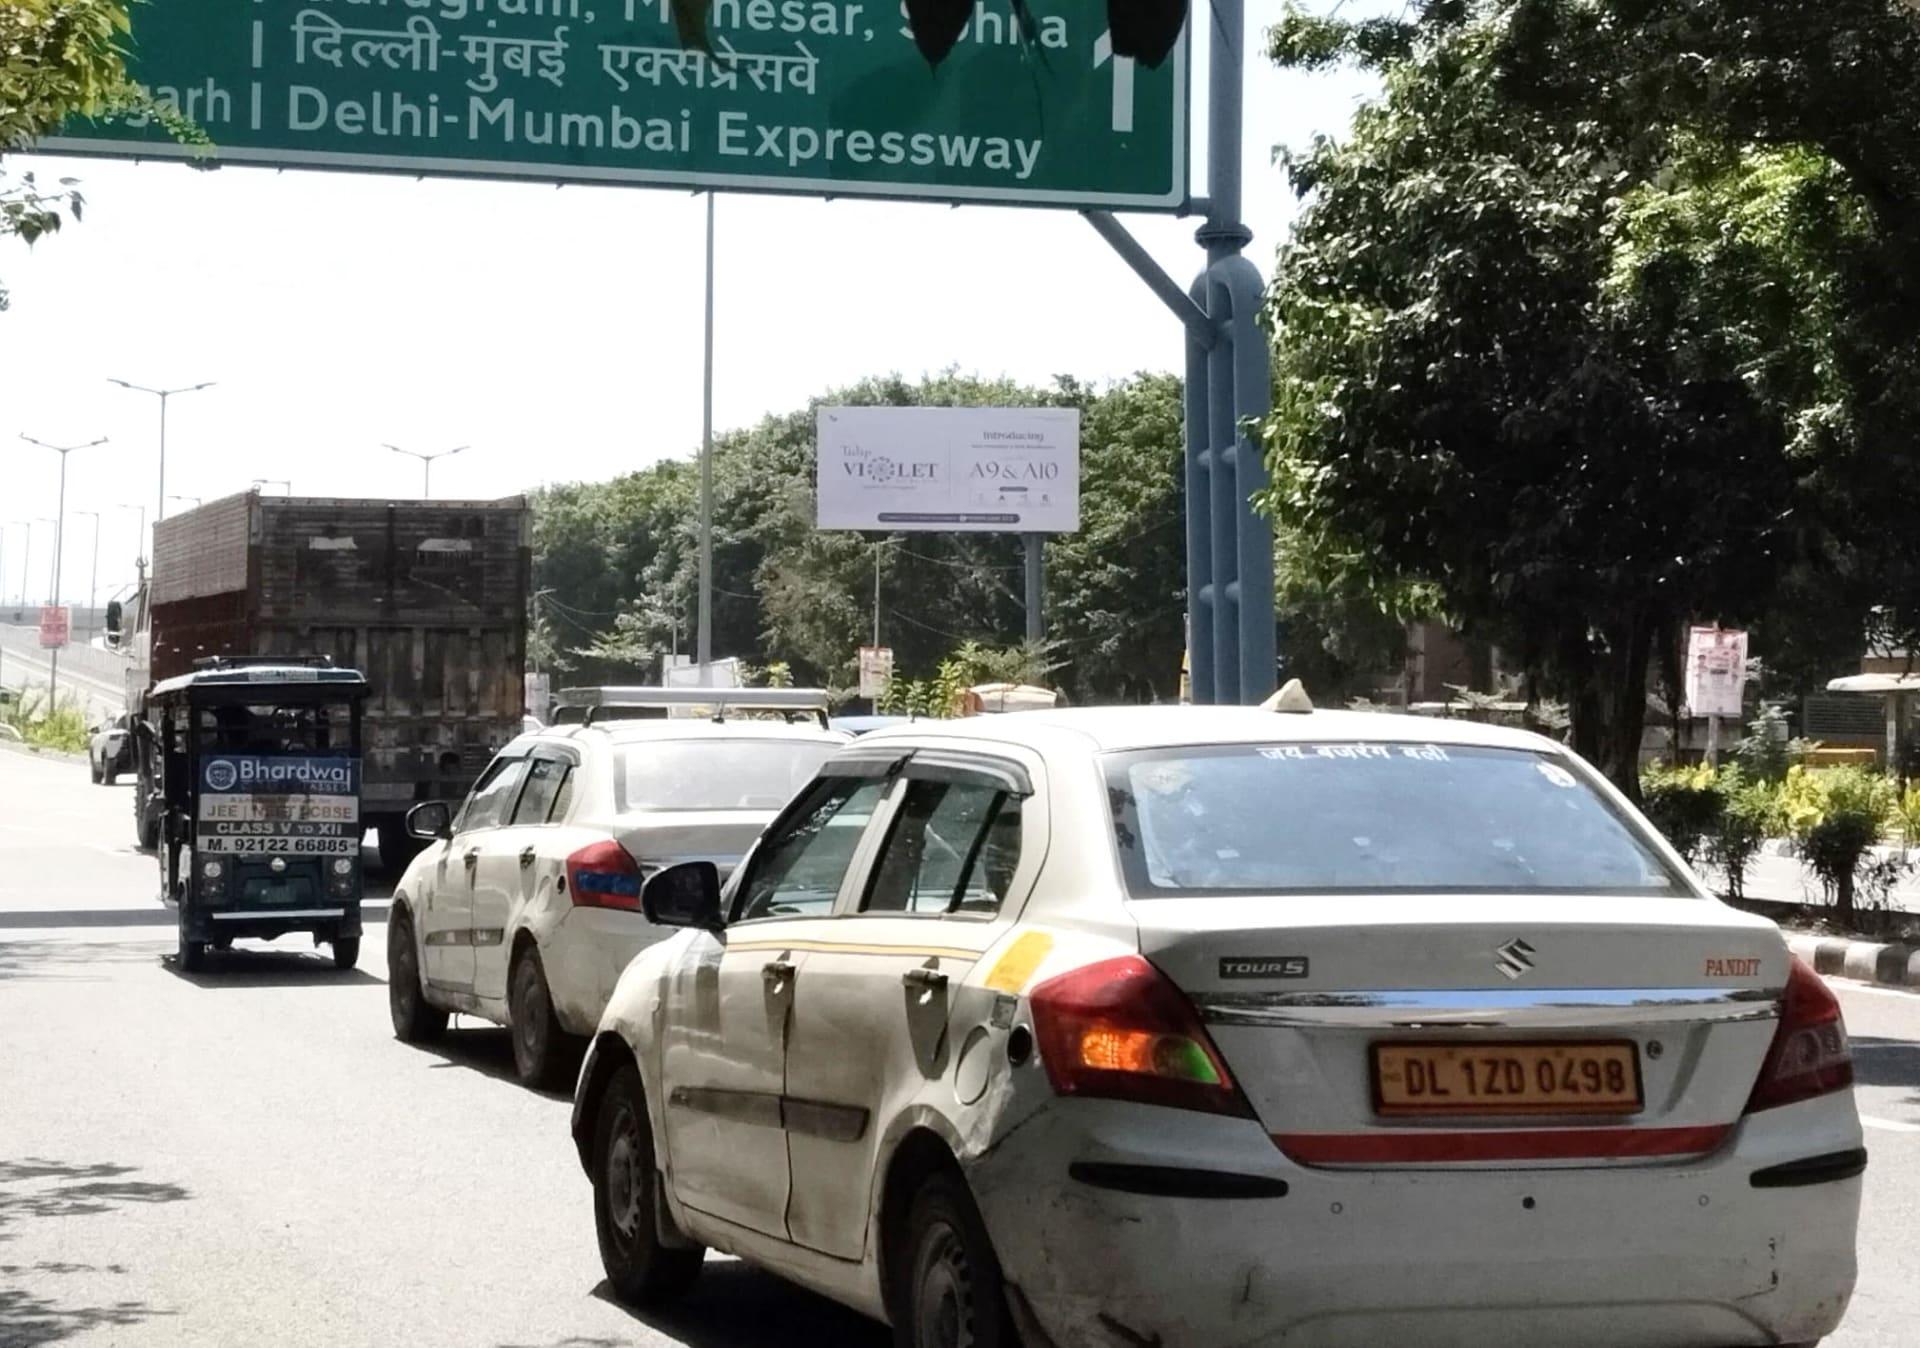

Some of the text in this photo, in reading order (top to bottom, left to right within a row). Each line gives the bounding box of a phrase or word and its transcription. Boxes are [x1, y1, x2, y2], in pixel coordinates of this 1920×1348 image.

[624, 0, 874, 41] Mnesar,
[291, 9, 569, 93] दिल्ली-मुंबई
[289, 84, 1043, 178] Delhi-Mumbai Expressway
[239, 760, 351, 791] Bhardwaj
[207, 805, 238, 817] JEE
[216, 823, 275, 834] CLASS
[279, 823, 293, 834] V
[207, 839, 228, 851] M.
[234, 839, 289, 852] 92122
[1704, 959, 1762, 977] PANDIT
[1404, 1056, 1626, 1096] DL 1ZD 0498
